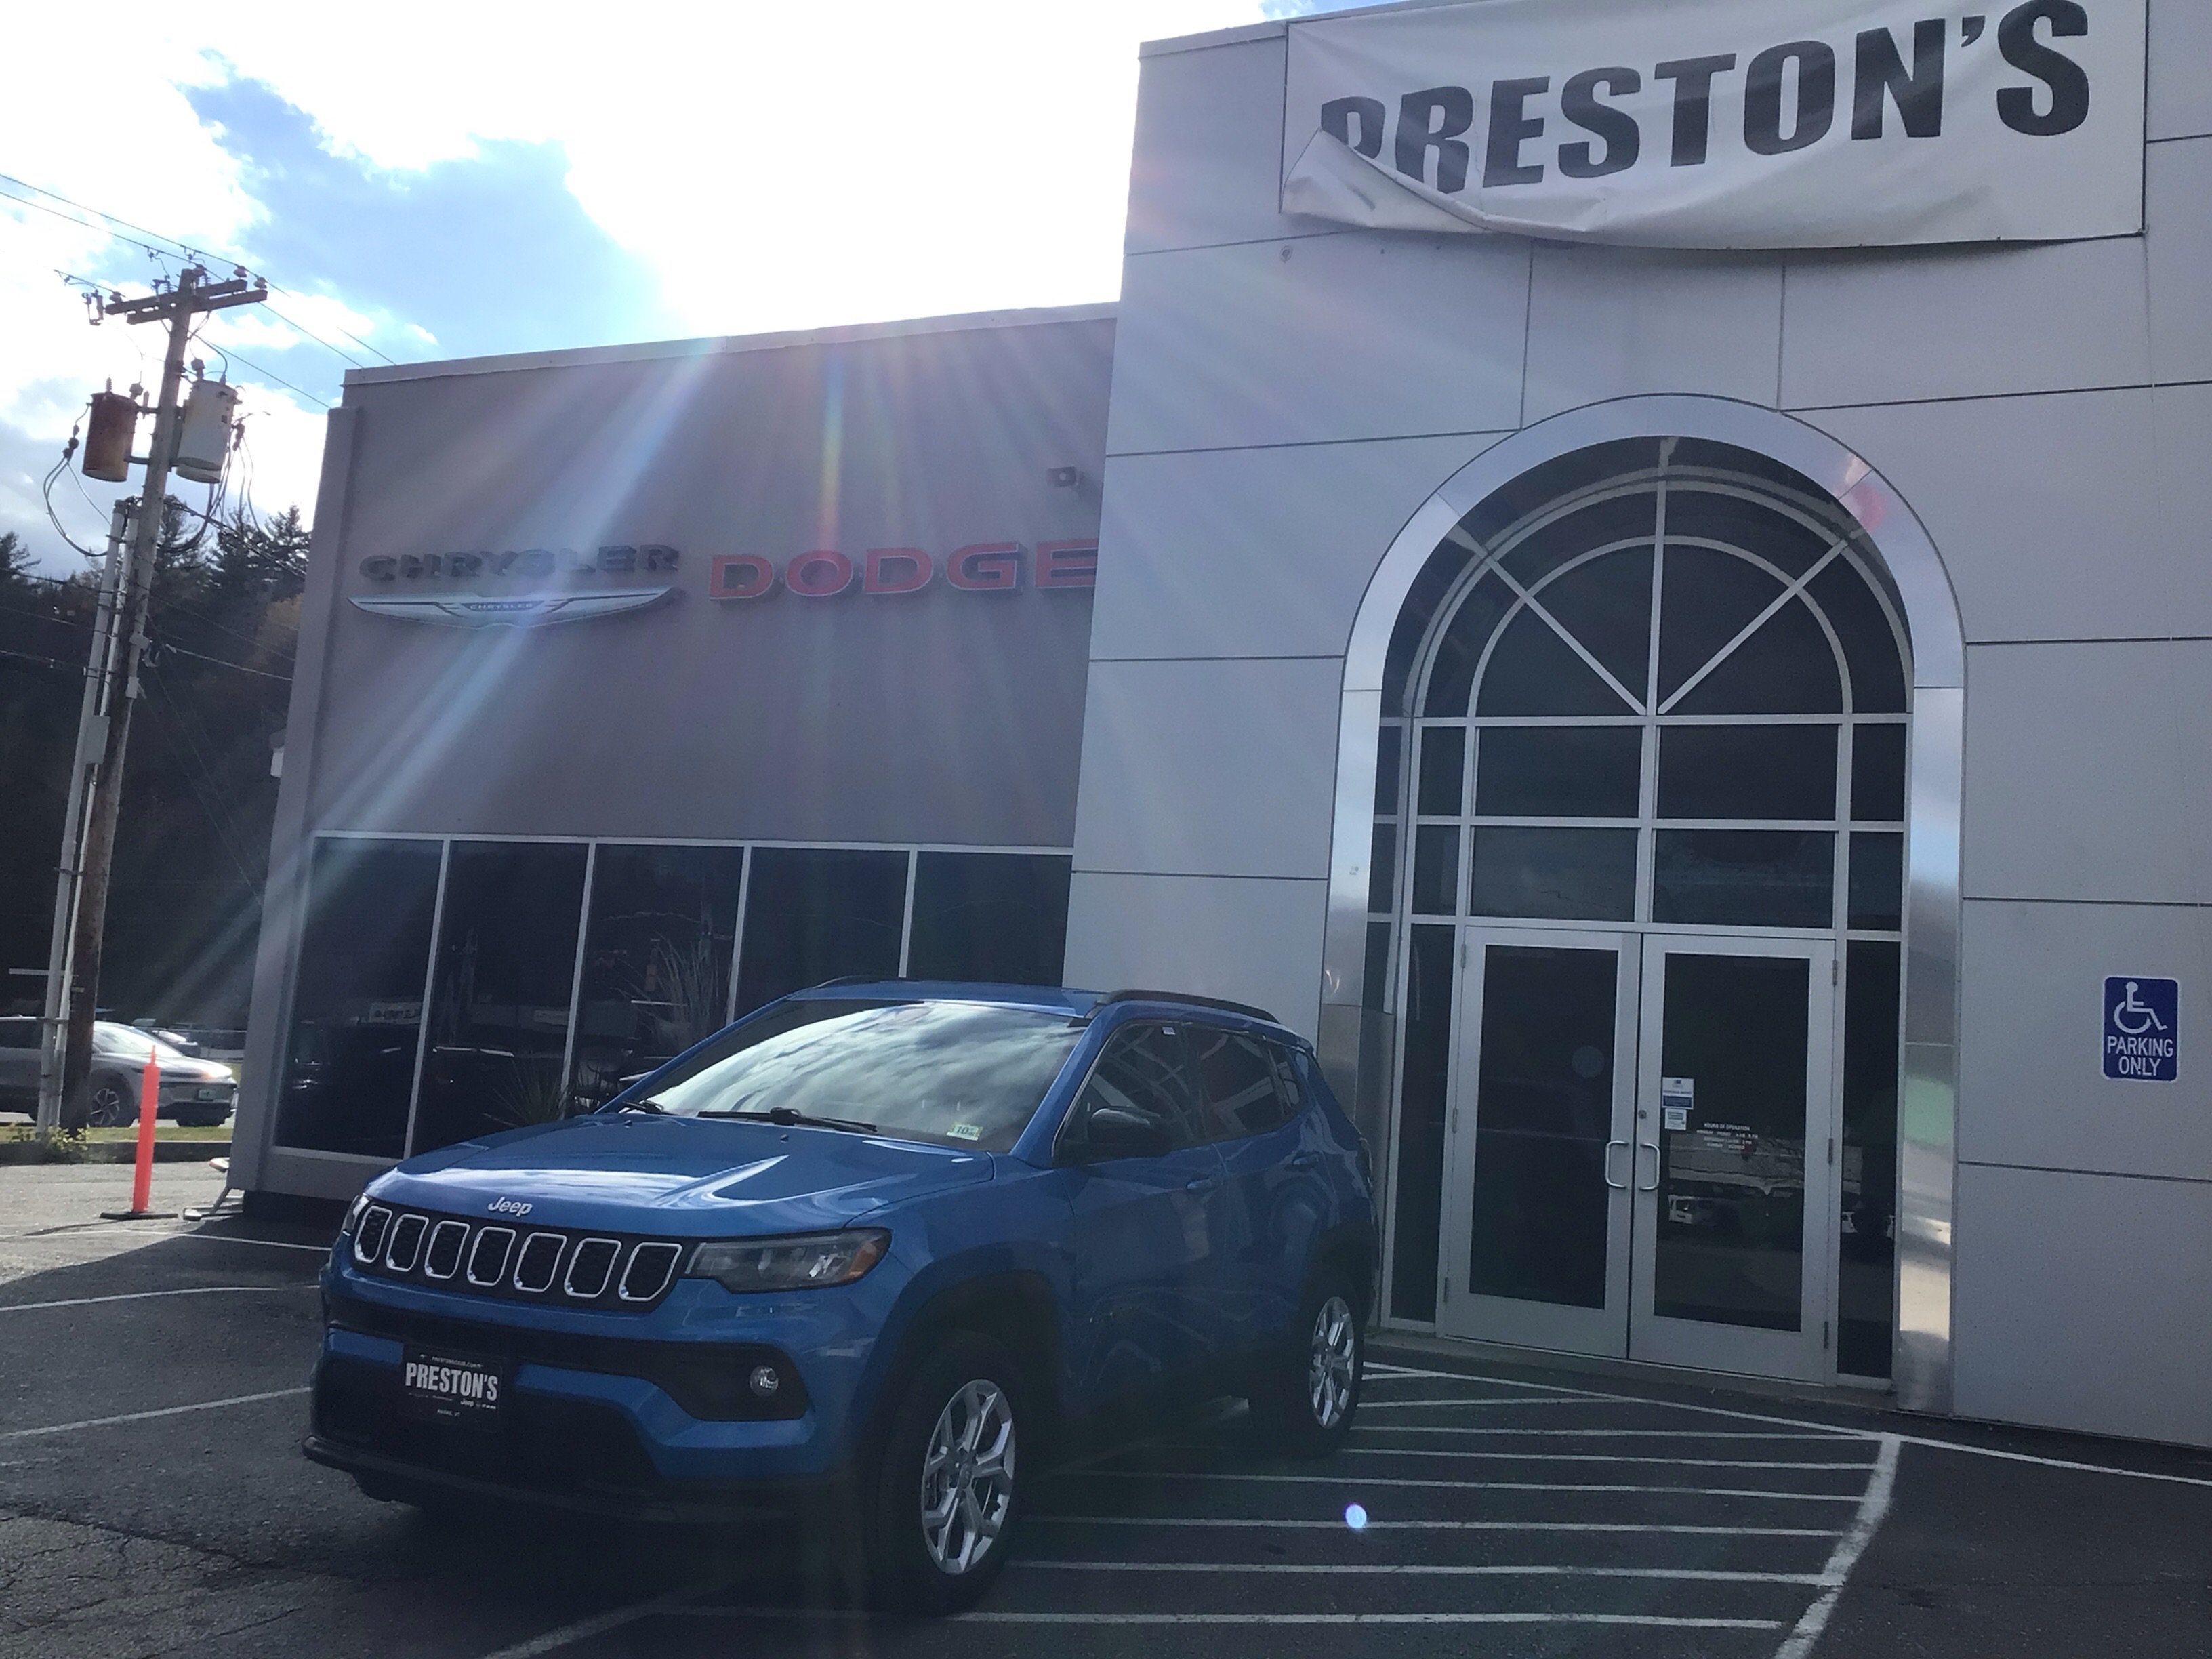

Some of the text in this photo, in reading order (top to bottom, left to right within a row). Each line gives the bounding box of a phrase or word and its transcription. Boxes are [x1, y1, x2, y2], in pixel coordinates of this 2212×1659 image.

[1321, 0, 2089, 194] PRESTON'S
[359, 544, 678, 582] CHRYSLER
[709, 539, 1099, 600] DODGE
[2107, 1036, 2173, 1057] PARKING
[2118, 1056, 2161, 1076] ONLY
[957, 1126, 969, 1134] 10
[488, 1197, 533, 1217] Jeep
[405, 1362, 498, 1401] PRESTON'S
